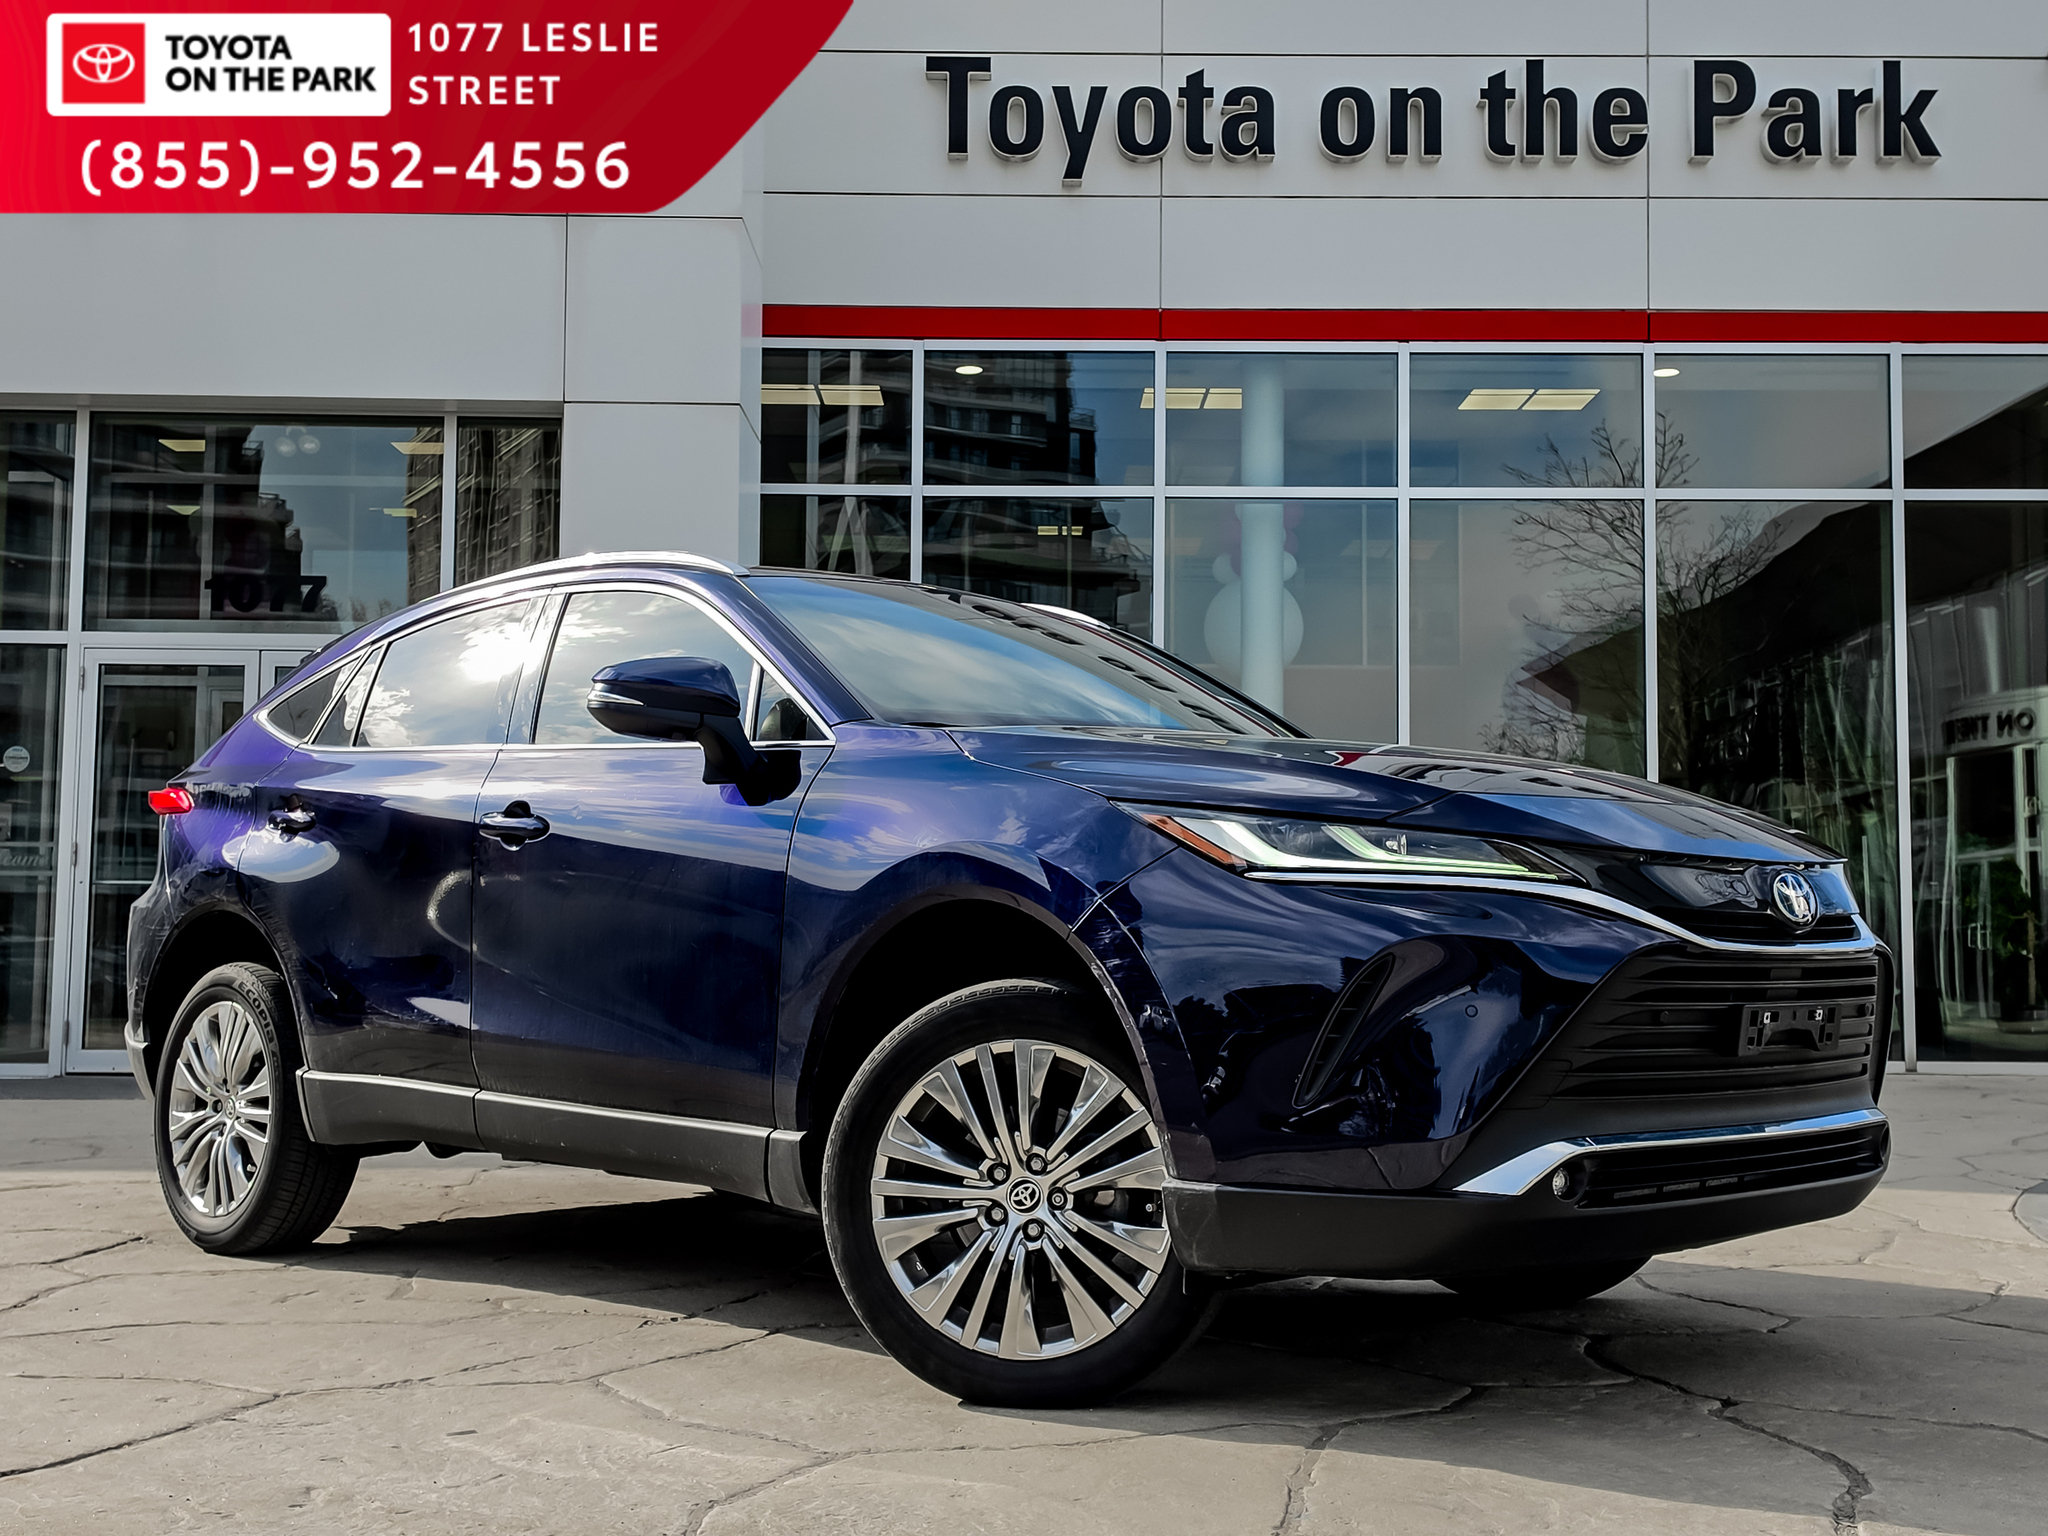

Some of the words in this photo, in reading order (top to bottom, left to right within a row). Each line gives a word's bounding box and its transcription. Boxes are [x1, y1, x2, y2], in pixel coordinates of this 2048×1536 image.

[926, 56, 1276, 187] Toyota
[1317, 85, 1443, 165] on
[1477, 59, 1650, 167] the
[1688, 58, 1942, 167] Park
[204, 575, 328, 613] 1077
